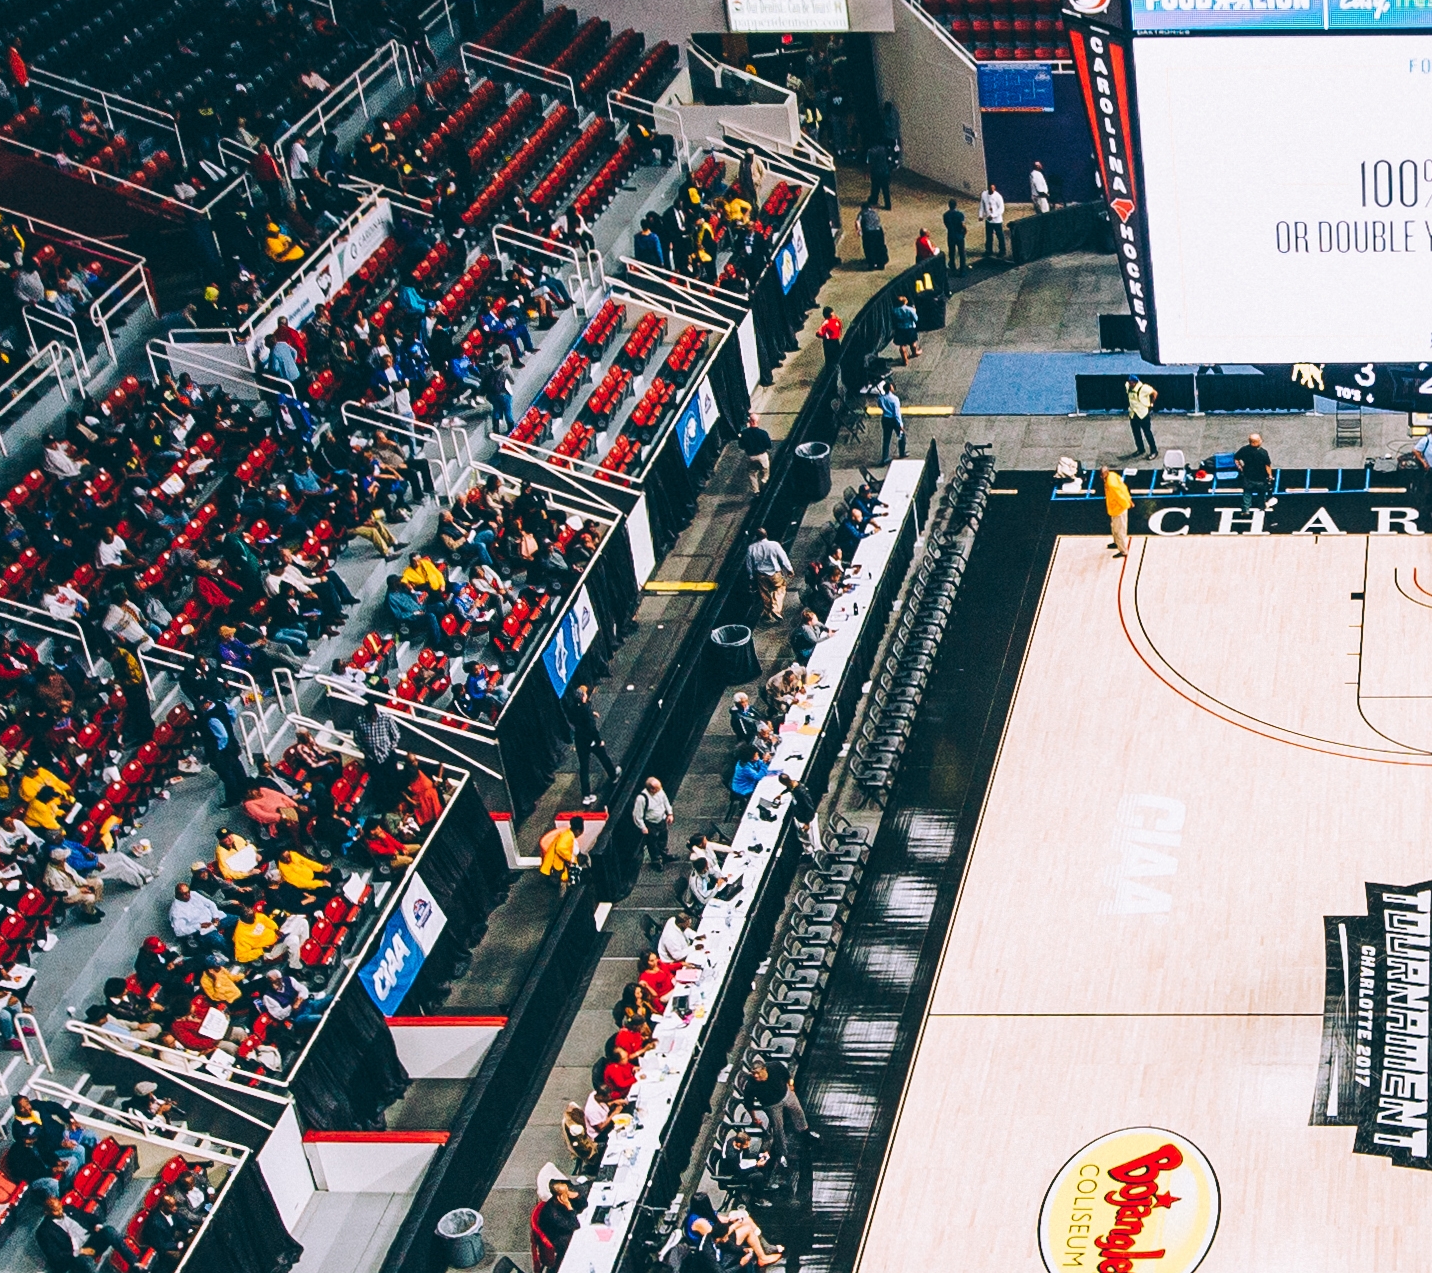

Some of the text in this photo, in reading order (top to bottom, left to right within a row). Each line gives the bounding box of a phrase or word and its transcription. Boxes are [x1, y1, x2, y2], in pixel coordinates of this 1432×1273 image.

[1089, 35, 1148, 334] CAROLINA HOCKEY
[1275, 220, 1310, 254] OR
[1318, 220, 1415, 253] DOUBLE
[1097, 791, 1187, 916] CIAA
[373, 930, 411, 1002] CIAA
[1354, 944, 1376, 1089] CHARLOTTE 2017
[1372, 889, 1432, 1160] TOURNAMENT
[1061, 1163, 1101, 1268] COLISEUM
